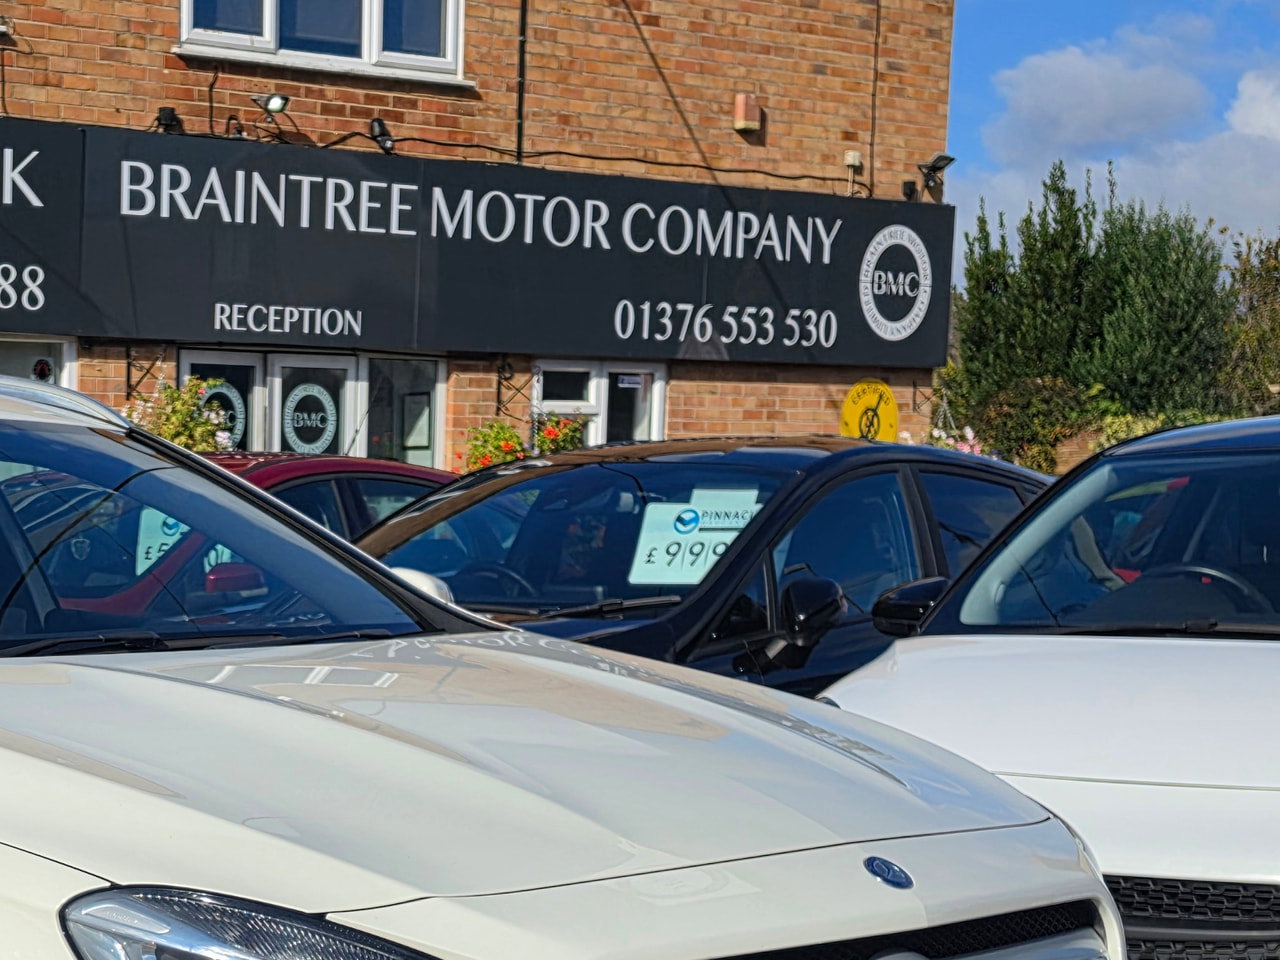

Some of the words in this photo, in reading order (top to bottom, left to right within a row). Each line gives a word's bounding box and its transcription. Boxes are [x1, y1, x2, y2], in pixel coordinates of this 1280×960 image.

[120, 160, 419, 236] BRAINTREE
[430, 186, 611, 250] MOTOR
[621, 202, 843, 264] COMPANY
[873, 270, 920, 297] BMC
[213, 303, 362, 336] RECEPTION
[614, 299, 714, 343] 01376
[720, 305, 775, 346] 553
[783, 309, 838, 348] 530
[293, 411, 328, 428] BMC
